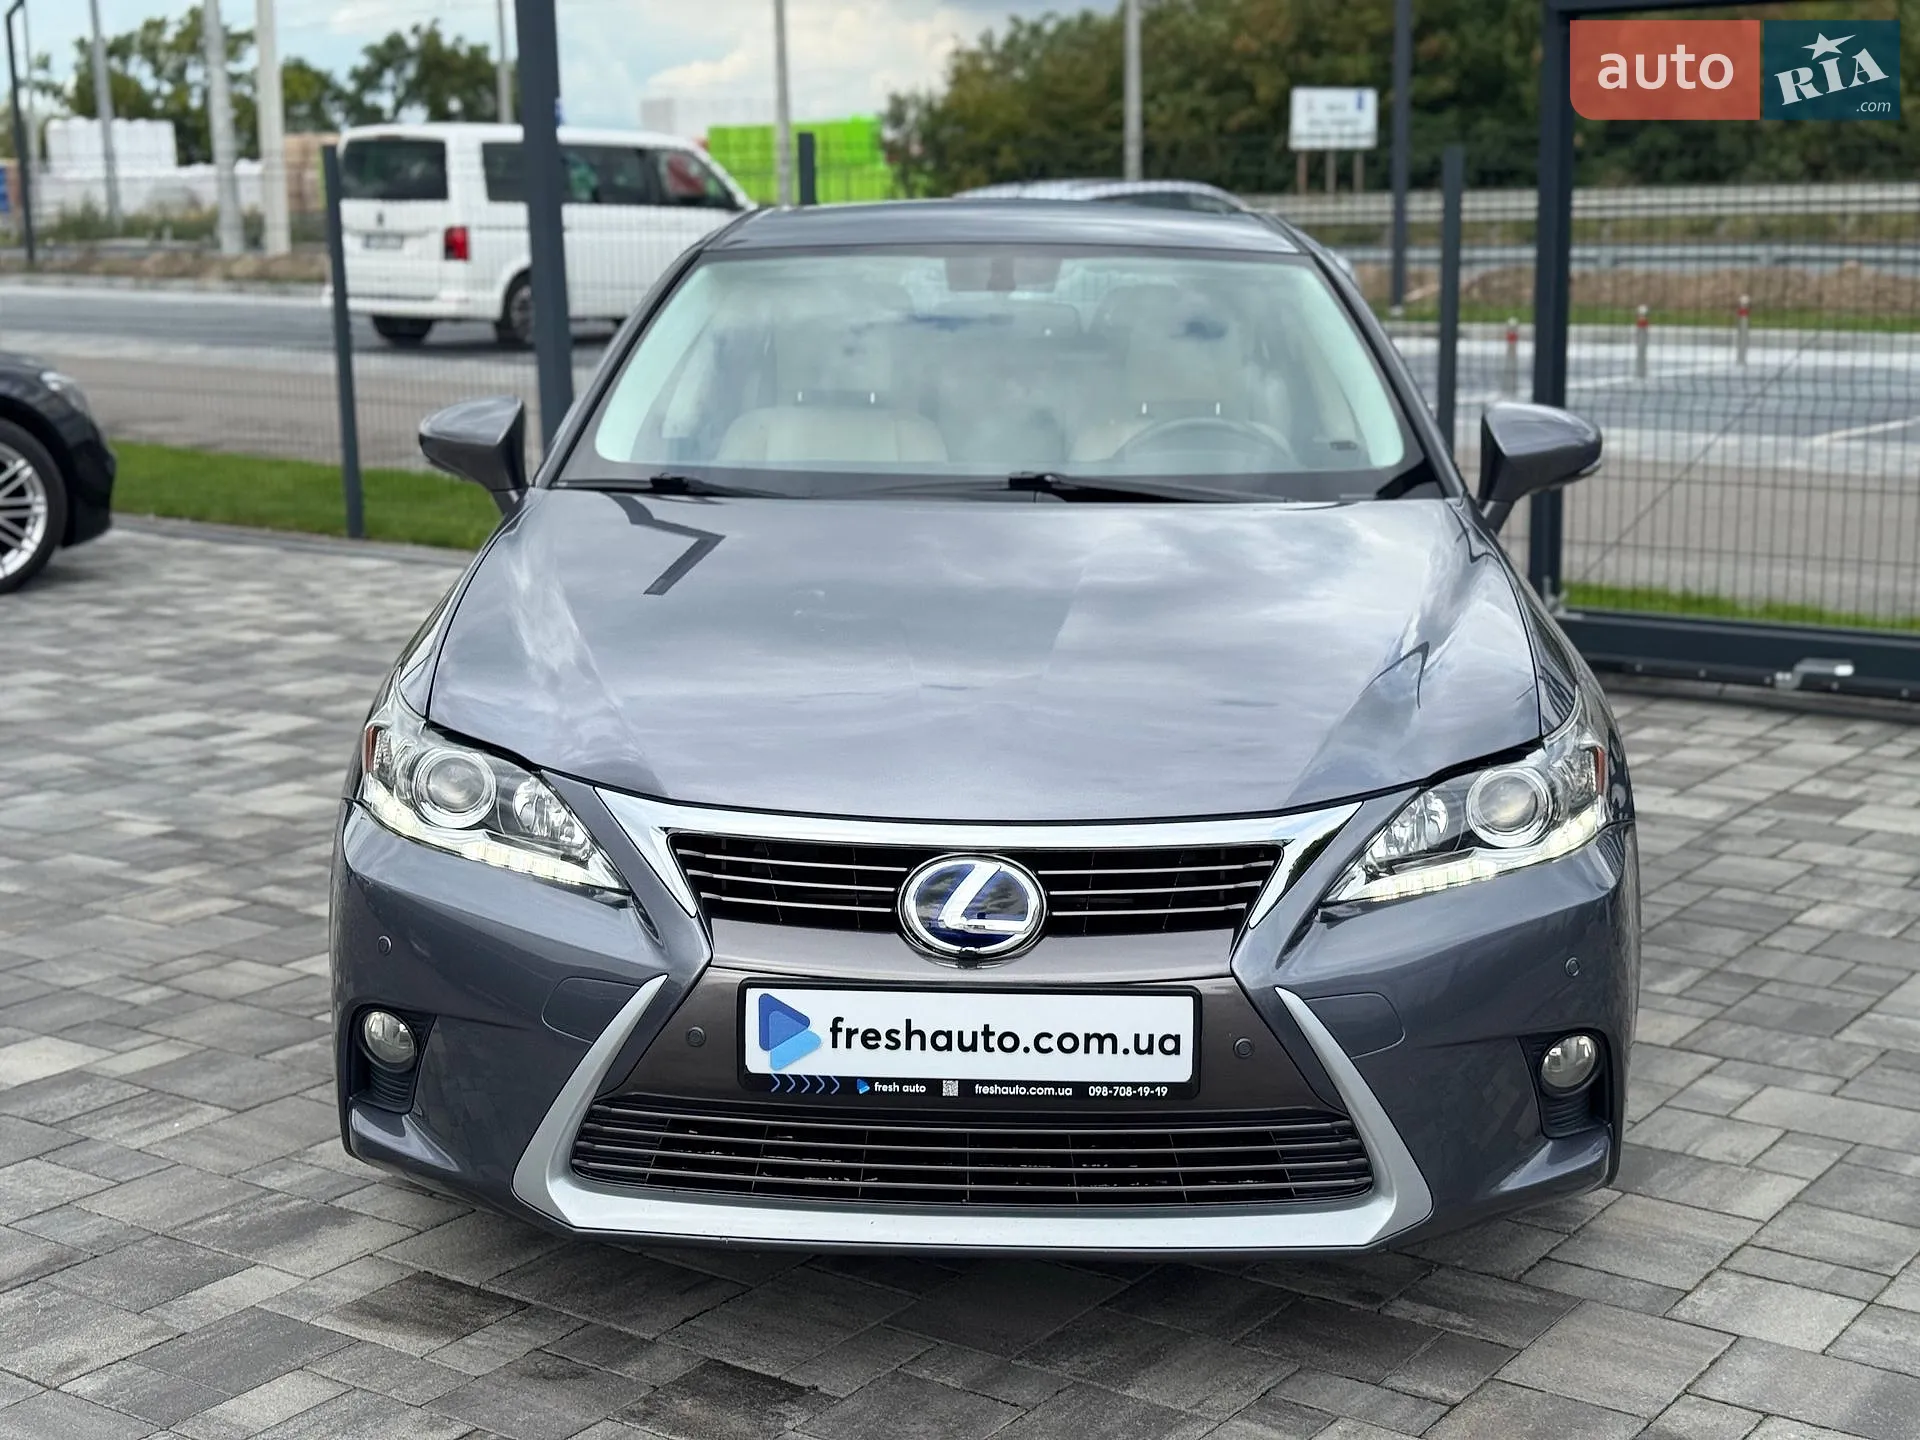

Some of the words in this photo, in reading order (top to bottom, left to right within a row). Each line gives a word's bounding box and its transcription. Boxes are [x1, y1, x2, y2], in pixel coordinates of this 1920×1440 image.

[829, 1016, 1182, 1056] freshauto.com.ua
[874, 1081, 900, 1093] fresh
[903, 1082, 927, 1093] auto
[974, 1083, 1073, 1097] freshauto.com.ua
[1088, 1086, 1169, 1098] 098-708-19-19
